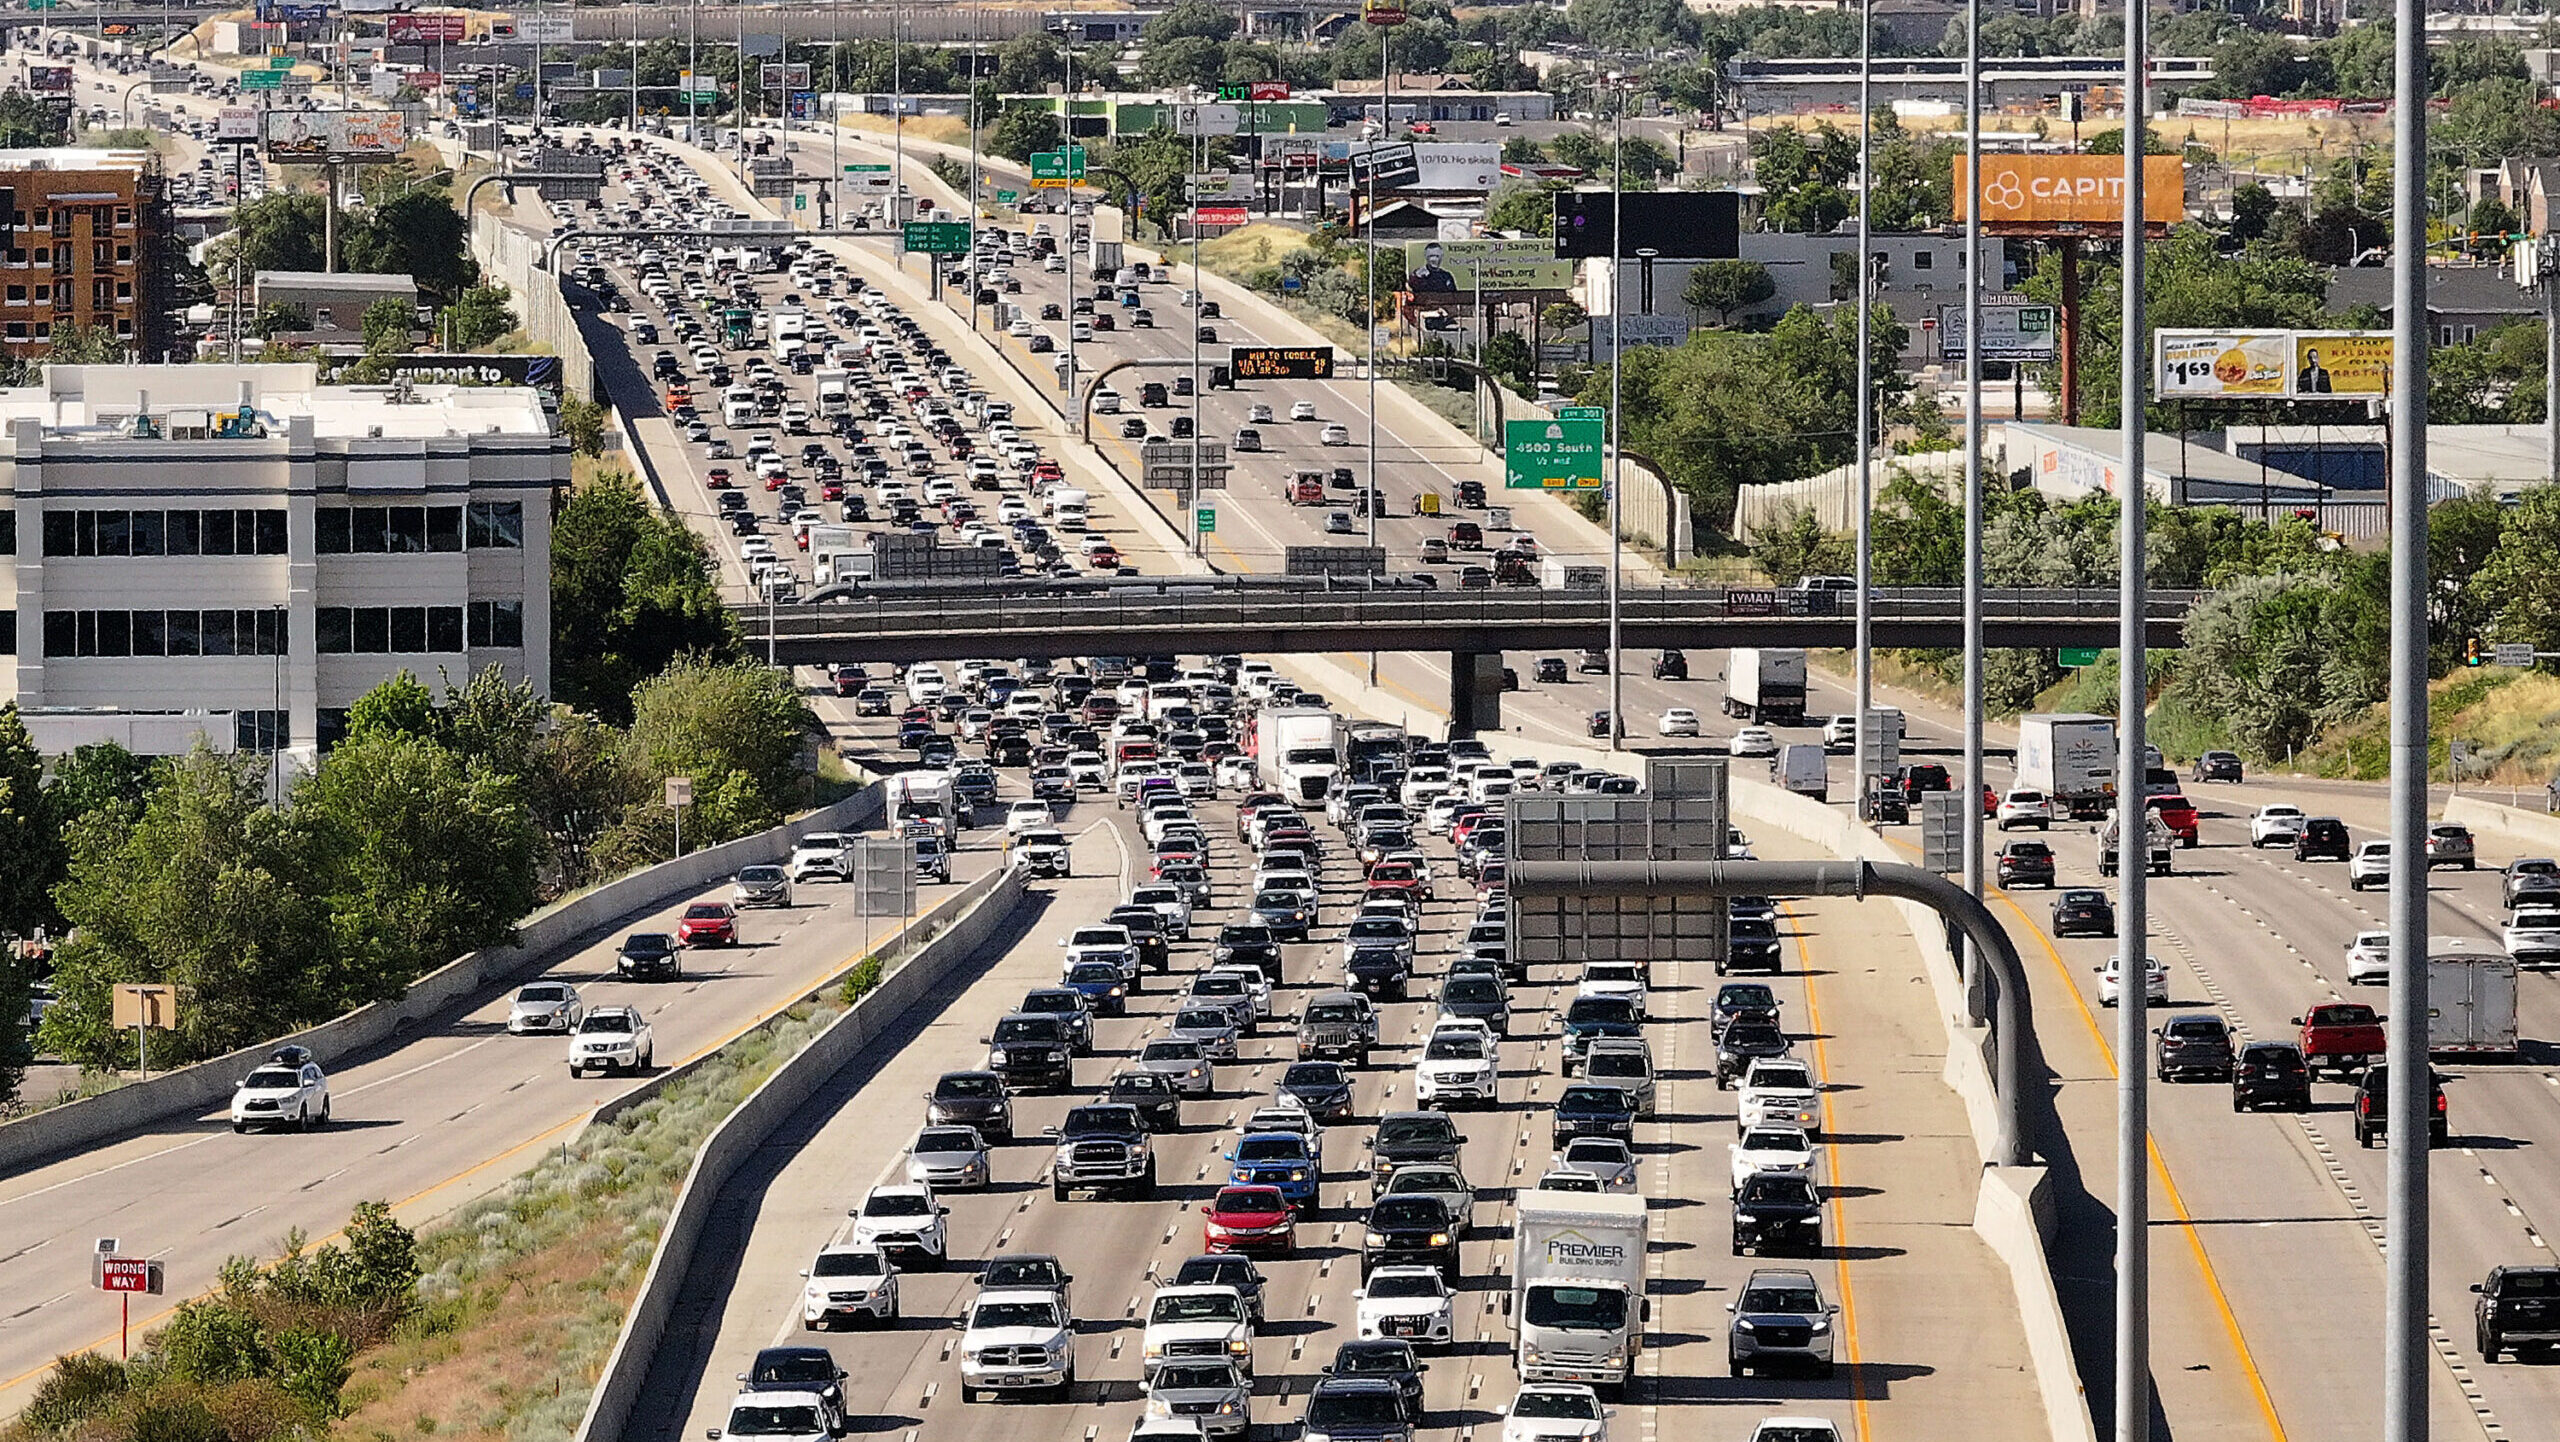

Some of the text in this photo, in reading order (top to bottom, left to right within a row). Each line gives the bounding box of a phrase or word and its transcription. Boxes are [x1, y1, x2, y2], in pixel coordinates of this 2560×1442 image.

[1240, 107, 1271, 124] atch
[2031, 177, 2147, 198] CAPIT
[1448, 244, 1486, 254] Imagine
[1507, 243, 1539, 252] Saving
[1989, 294, 2029, 304] HIRING
[1269, 351, 1280, 360] TO
[396, 365, 474, 383] support
[480, 365, 501, 382] to
[2333, 369, 2393, 377] BROTH
[1584, 408, 1600, 418] 301
[1516, 442, 1593, 453] 4500 South
[1553, 457, 1571, 465] MILE
[1731, 593, 1772, 604] LYMAN
[1548, 1240, 1623, 1258] PREMIER
[1559, 1257, 1593, 1266] BUILDING
[104, 1262, 145, 1274] WRONG
[112, 1276, 137, 1288] WAY
